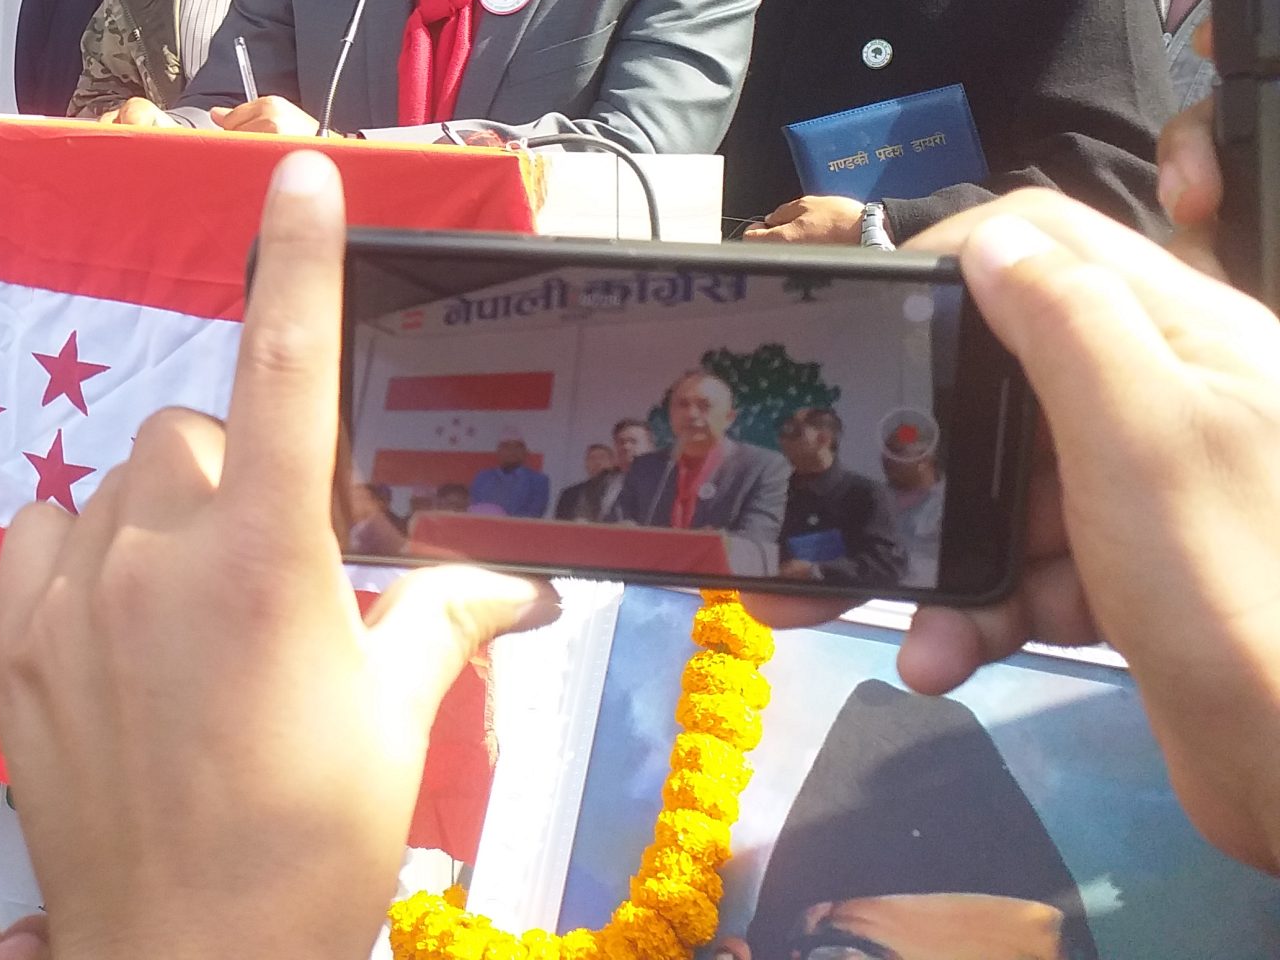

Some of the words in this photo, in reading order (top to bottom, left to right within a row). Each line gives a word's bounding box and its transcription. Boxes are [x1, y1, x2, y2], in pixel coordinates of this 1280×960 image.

[828, 151, 869, 172] गण्डकी
[875, 144, 904, 162] प्रदेश
[910, 132, 946, 153] डायरी
